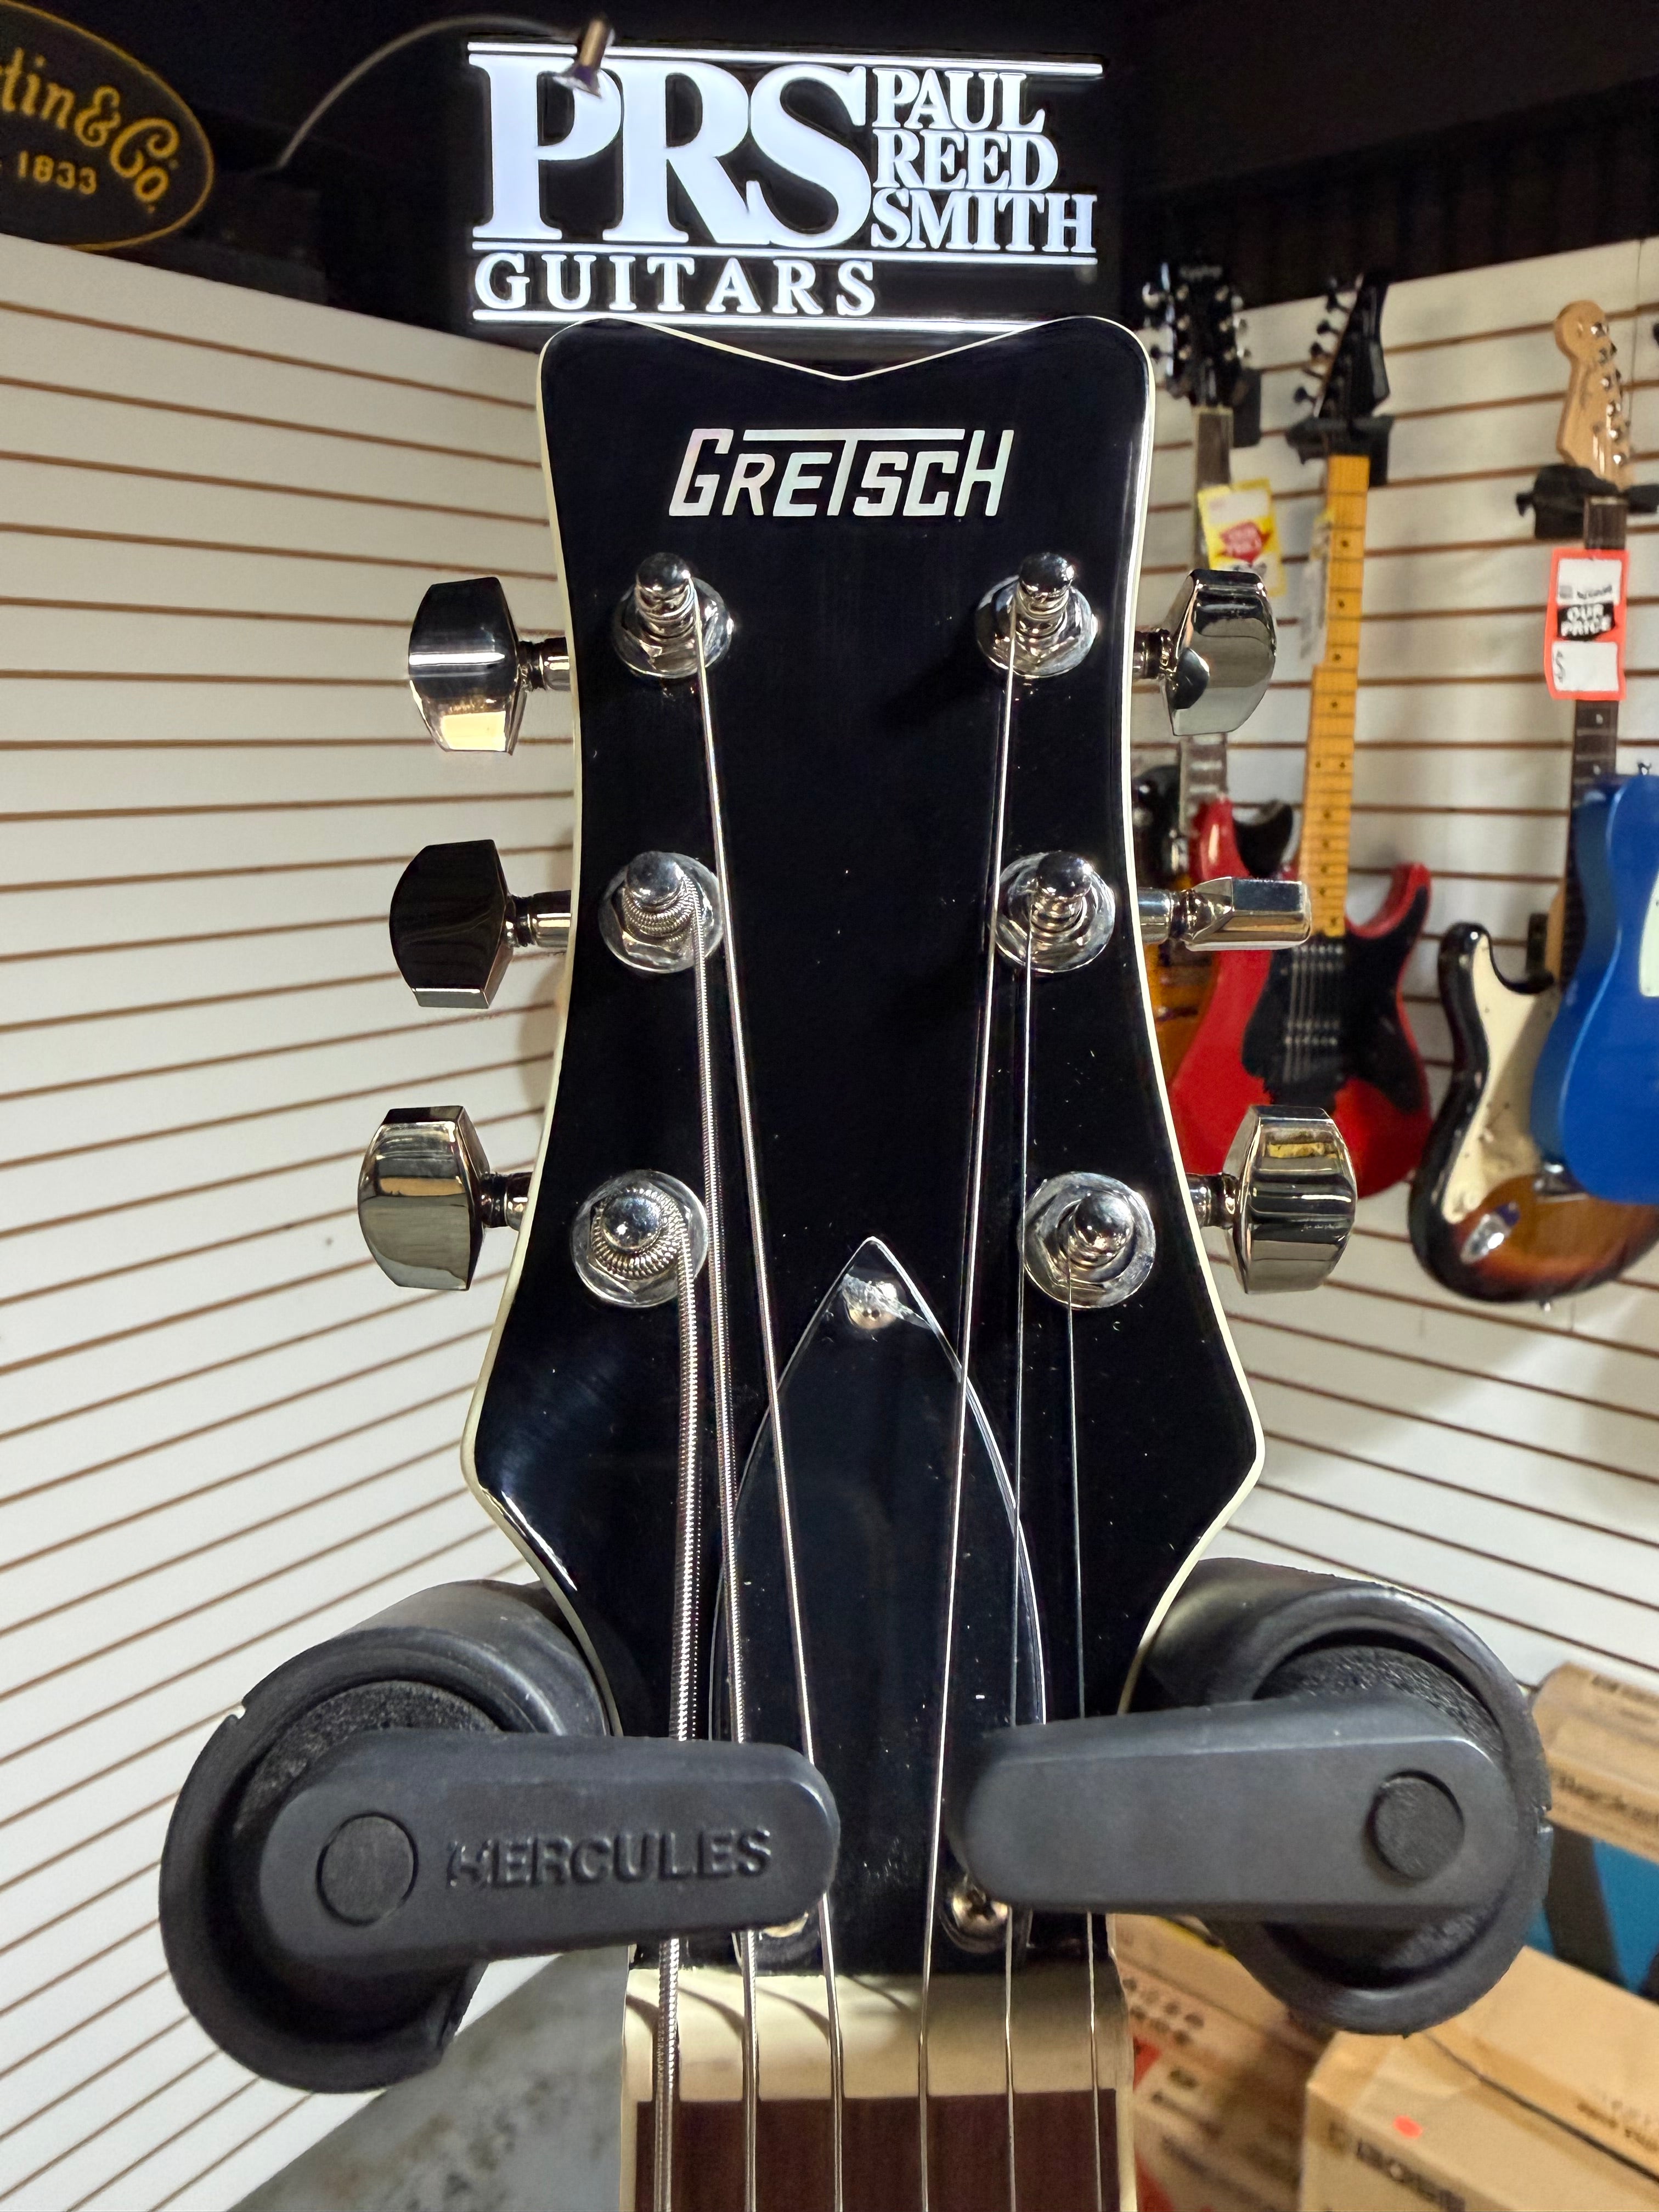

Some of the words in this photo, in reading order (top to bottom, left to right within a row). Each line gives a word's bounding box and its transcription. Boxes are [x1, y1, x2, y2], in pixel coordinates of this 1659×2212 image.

[872, 68, 1046, 133] PAUL
[18, 150, 97, 195] 1833
[469, 54, 872, 249] PRS
[872, 129, 1059, 191] REED
[871, 188, 1097, 253] SMITH
[474, 252, 876, 316] GUITARS
[445, 1826, 771, 1888] HERCULES
